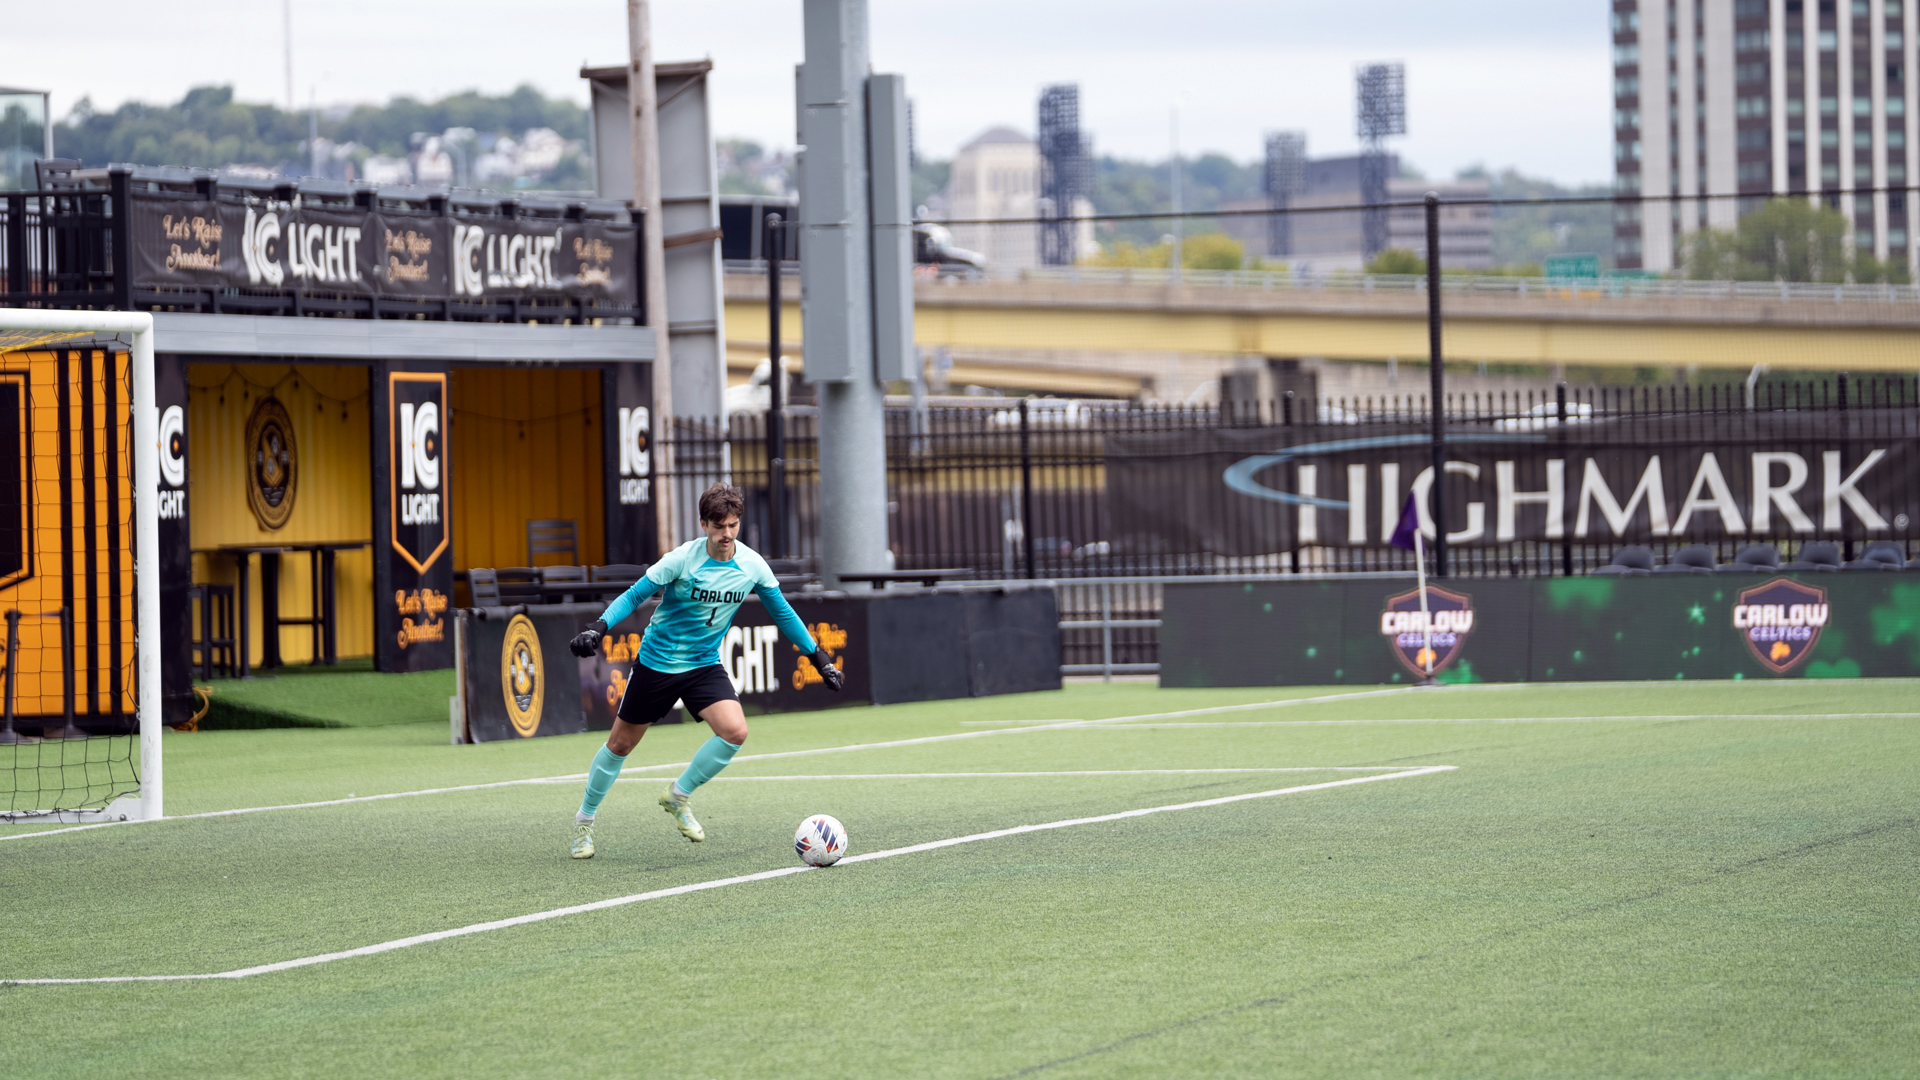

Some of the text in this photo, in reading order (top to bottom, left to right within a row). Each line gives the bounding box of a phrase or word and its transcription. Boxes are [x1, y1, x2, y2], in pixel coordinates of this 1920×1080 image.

[163, 214, 223, 248] Let's Raise
[166, 243, 222, 273] Another!
[287, 221, 361, 282] LIGHT
[487, 234, 562, 289] LIGHT
[620, 478, 650, 504] LIGHT
[1298, 449, 1890, 543] HIGHMARK
[401, 493, 440, 525] LIGHT
[690, 587, 746, 604] CARLOW
[705, 606, 718, 627] 1
[1381, 610, 1474, 635] CARLOW
[1733, 603, 1828, 629] CARLOW
[1749, 626, 1812, 642] CELTICS
